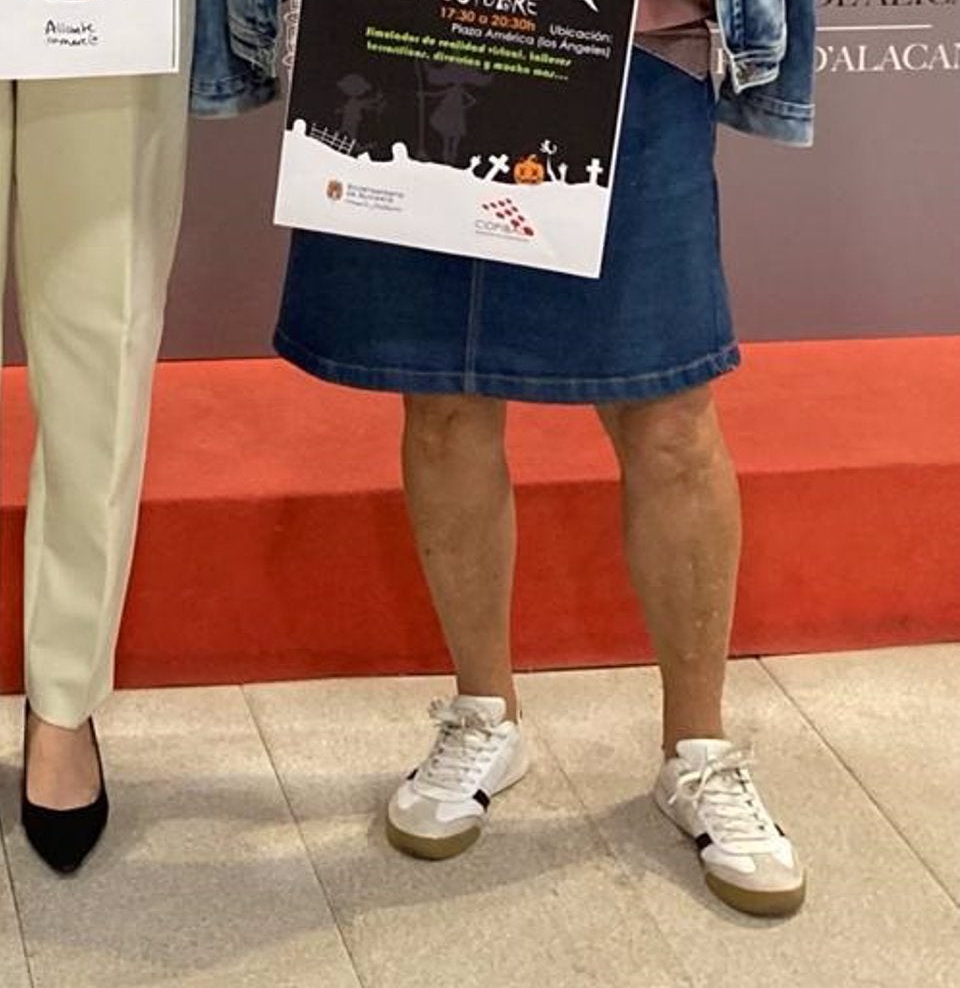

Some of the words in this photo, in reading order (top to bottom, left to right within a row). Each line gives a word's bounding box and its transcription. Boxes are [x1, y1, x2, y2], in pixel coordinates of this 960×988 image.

[440, 6, 475, 23] 17:30
[478, 13, 488, 24] a
[491, 13, 536, 31] 20:30h
[451, 23, 483, 37] Plaza
